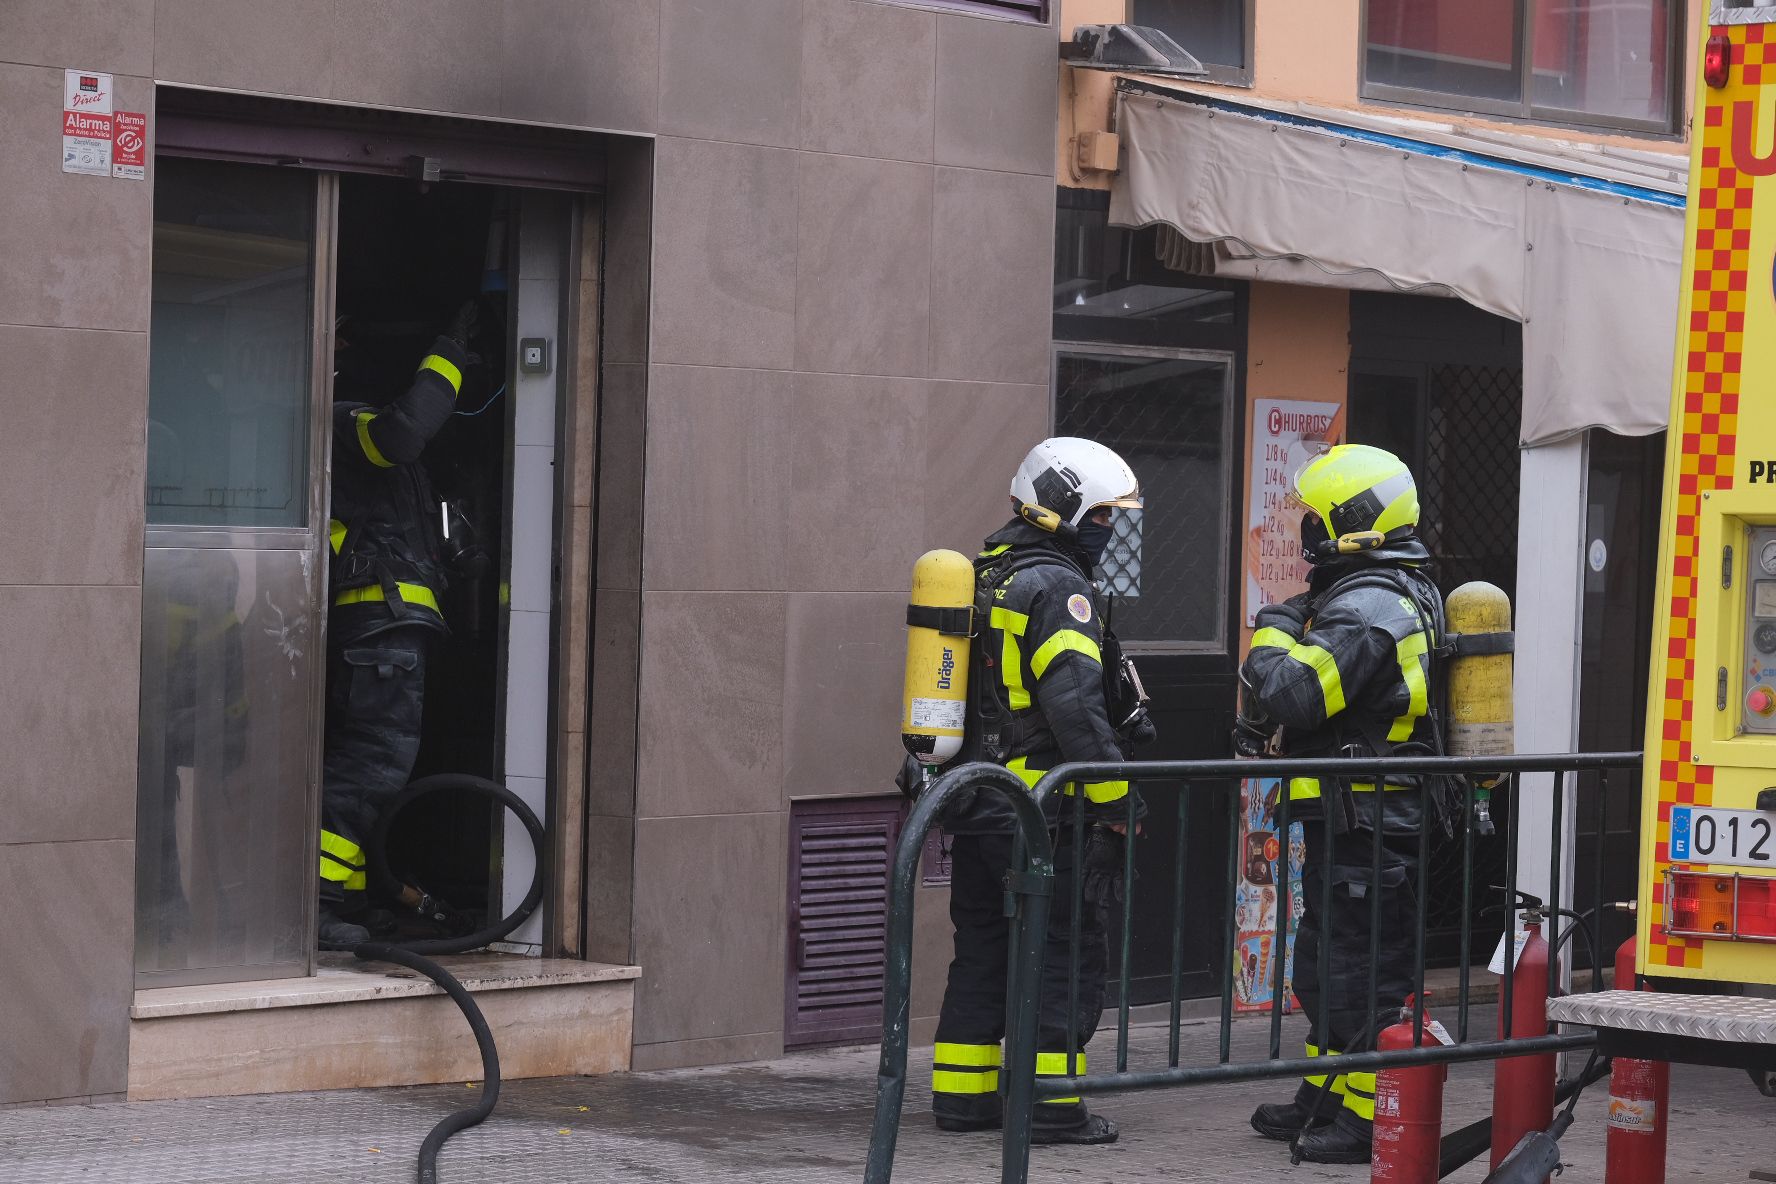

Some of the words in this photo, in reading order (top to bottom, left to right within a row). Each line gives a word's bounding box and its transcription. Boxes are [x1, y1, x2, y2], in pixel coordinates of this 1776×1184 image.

[66, 113, 110, 130] Alarma
[116, 114, 144, 125] Alarma
[1268, 407, 1327, 435] CHURROS
[1266, 443, 1278, 461] 1/8
[1264, 468, 1277, 486] 1/4
[1263, 491, 1276, 510] 1/4
[1262, 516, 1275, 533] 1/2
[1261, 540, 1274, 557] 1/2
[1281, 540, 1294, 558] 1/8
[1260, 563, 1273, 580] 1/2
[1281, 563, 1294, 581] 1/4
[1260, 587, 1264, 604] 1
[937, 647, 954, 690] Dräger
[1676, 839, 1685, 852] E
[1694, 814, 1771, 861] 012
